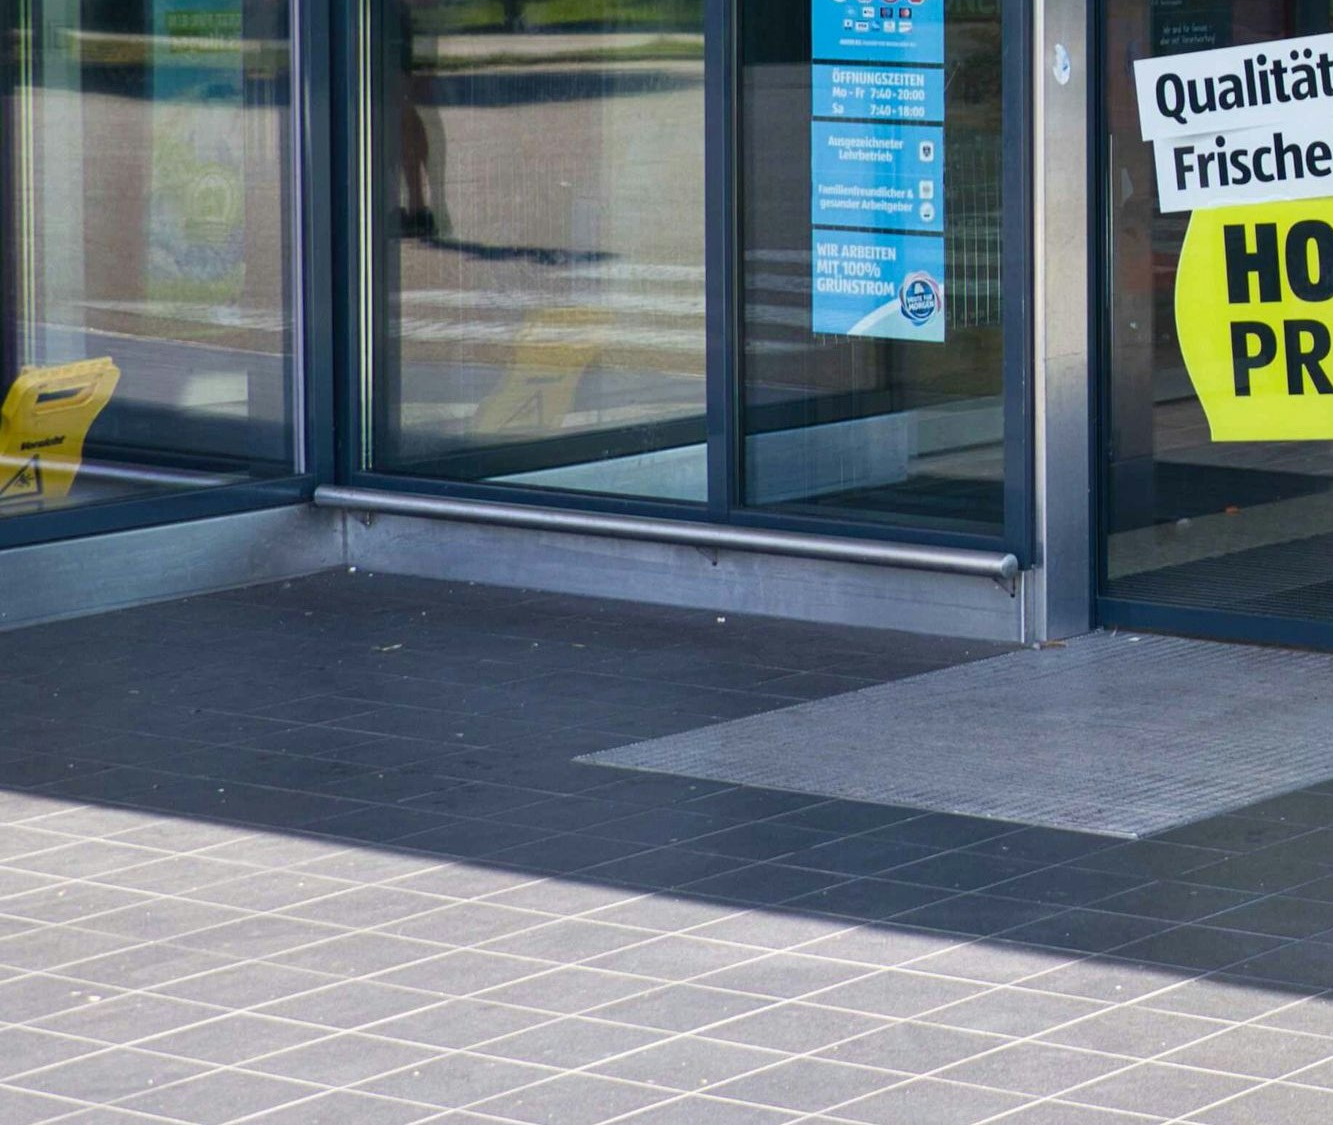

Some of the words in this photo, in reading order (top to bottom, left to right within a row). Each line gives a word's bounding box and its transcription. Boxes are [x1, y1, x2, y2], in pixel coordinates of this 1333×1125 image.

[832, 68, 925, 87] ÖFFNUNGSZEITEN
[832, 88, 847, 100] Mo
[855, 88, 865, 100] Fr
[832, 103, 844, 115] Sa
[828, 135, 904, 152] Ausgezeichneter
[838, 147, 893, 163] Lehrbetrieb
[1173, 133, 1332, 190] Frische
[818, 184, 904, 199] Familienfreundlicher
[819, 198, 859, 213] gesunder
[861, 198, 913, 214] Arbeitgeber
[817, 243, 840, 257] WIR
[841, 243, 896, 260] ARBEITEN
[817, 260, 839, 274] MIT
[842, 261, 881, 277] 100%
[817, 276, 895, 296] GRÜNSTROM
